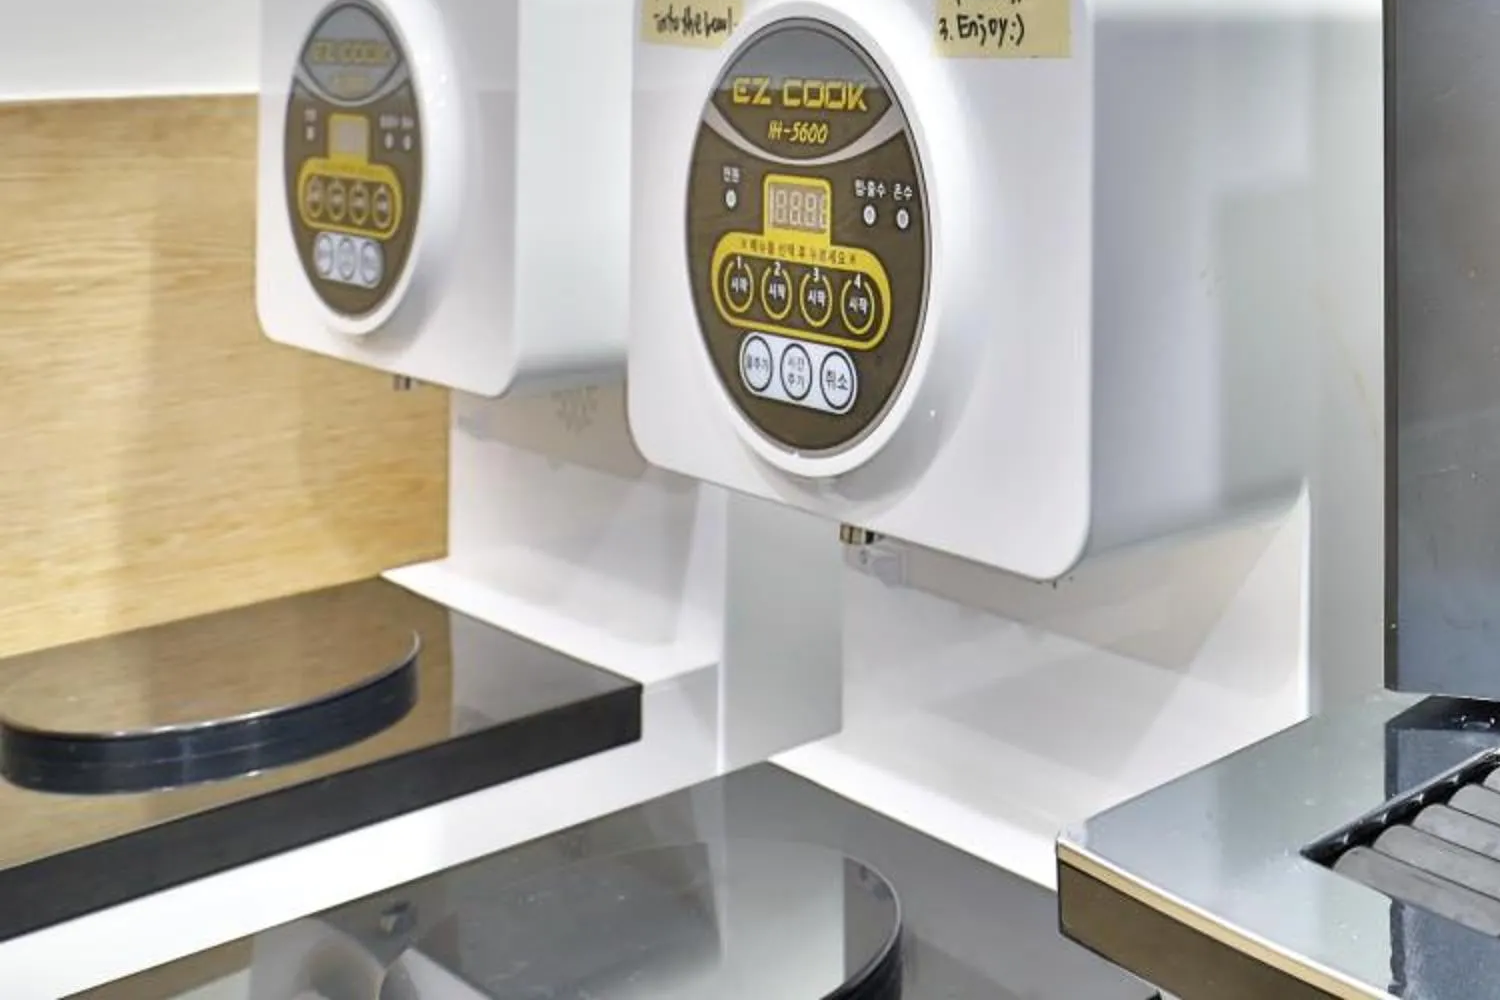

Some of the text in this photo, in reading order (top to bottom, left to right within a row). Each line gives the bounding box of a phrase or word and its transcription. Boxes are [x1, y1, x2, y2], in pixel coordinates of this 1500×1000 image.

[733, 76, 868, 113] EZ COOK
[774, 261, 781, 276] 2
[813, 267, 820, 283] 3
[854, 273, 861, 289] 4
[825, 369, 849, 391] 취소
